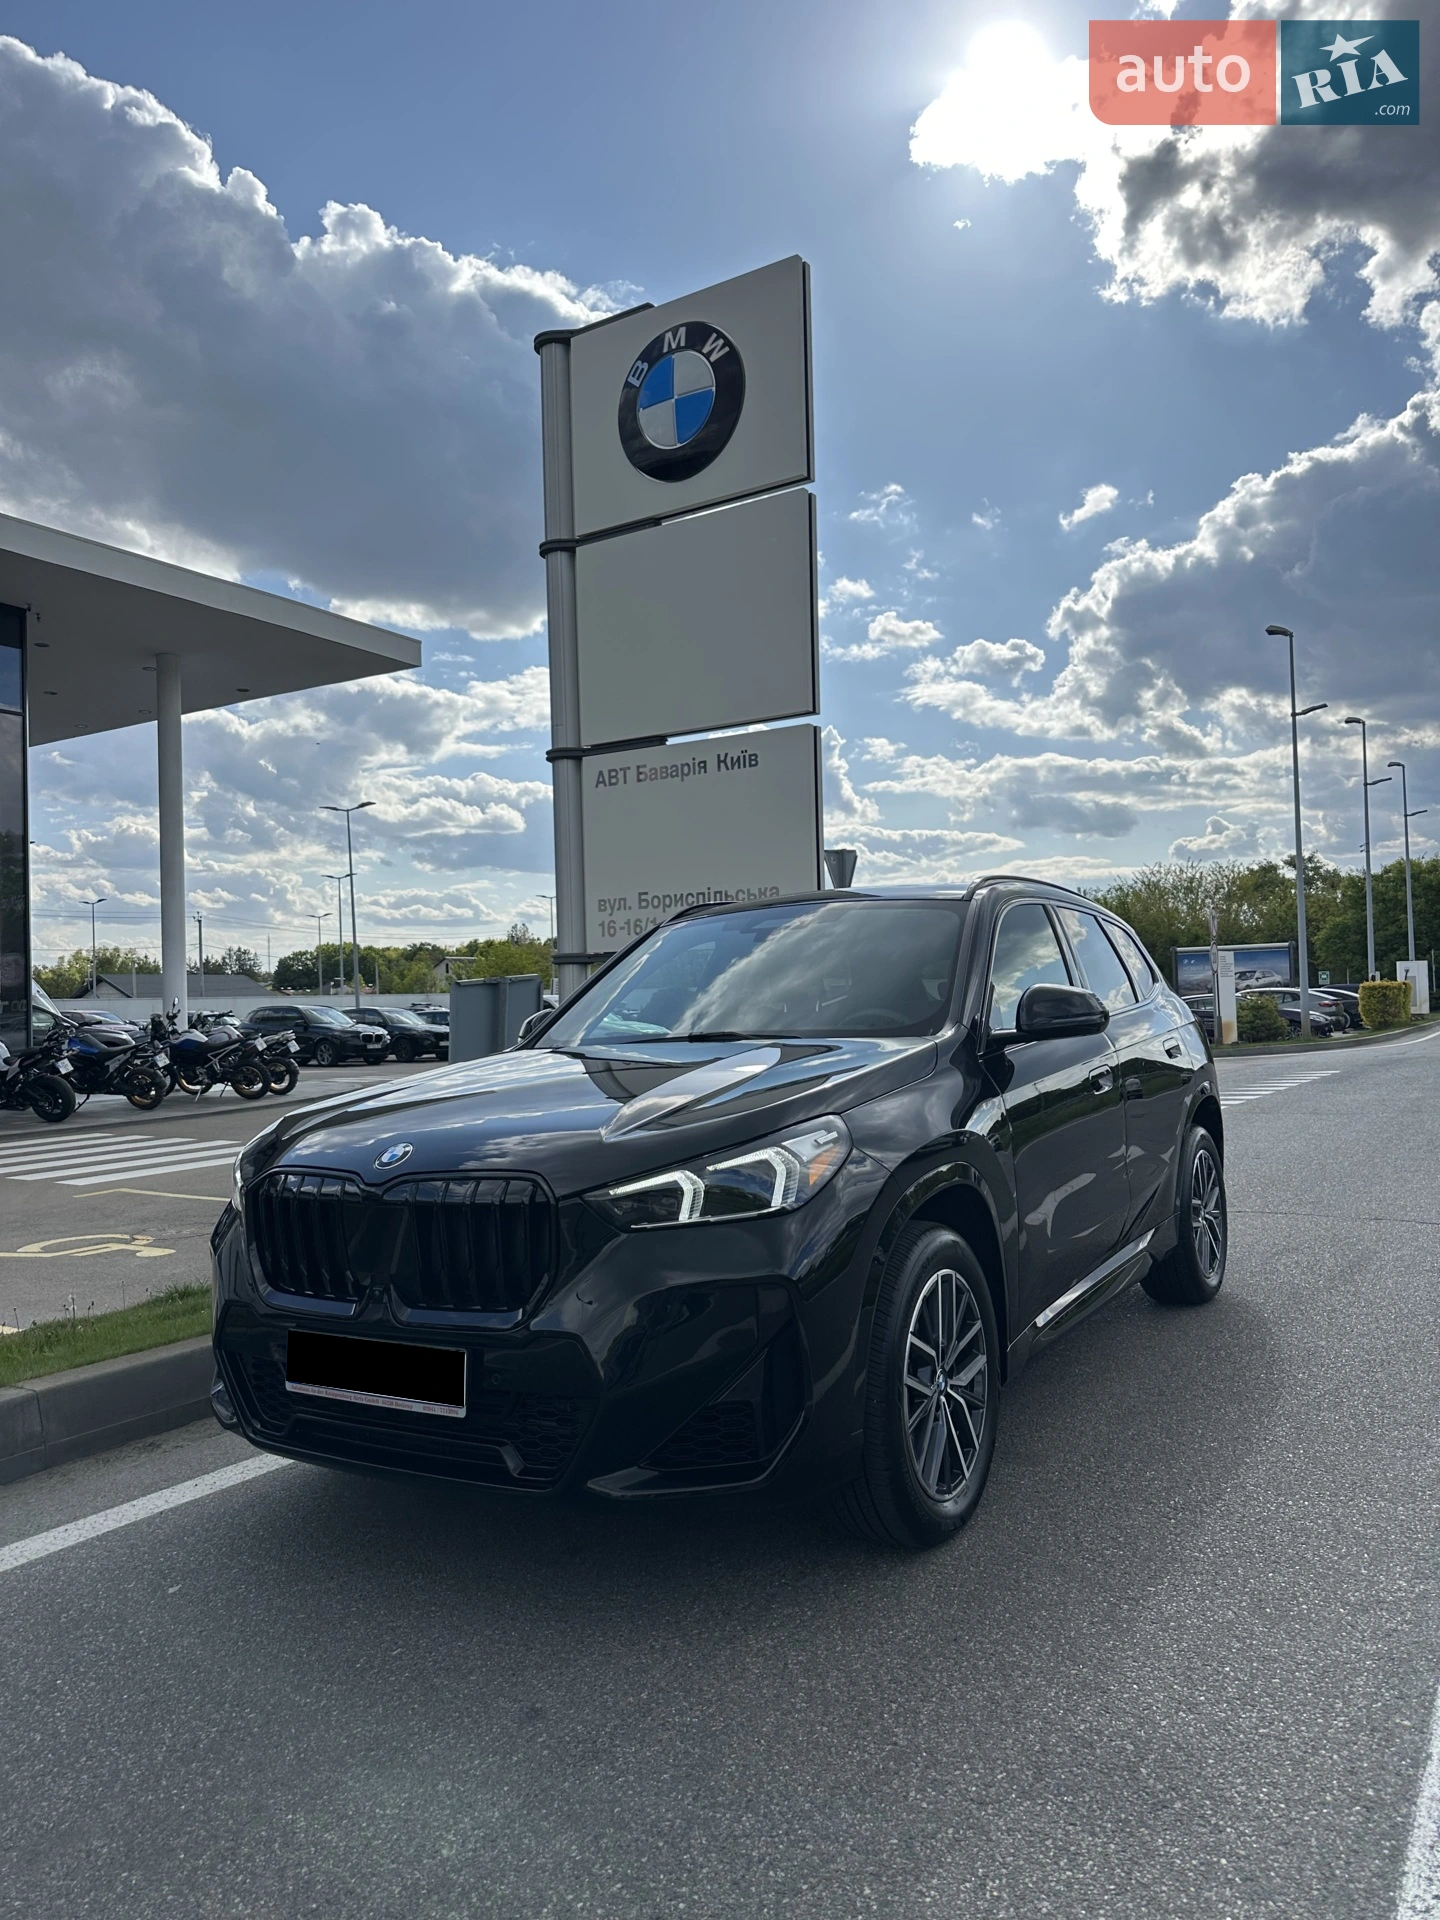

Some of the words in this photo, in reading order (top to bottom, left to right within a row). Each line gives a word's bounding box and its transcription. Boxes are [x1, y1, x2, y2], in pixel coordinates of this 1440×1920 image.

[627, 326, 730, 388] BMW
[595, 766, 631, 788] АВТ
[636, 757, 708, 782] Баварія
[717, 750, 759, 772] Київ
[598, 897, 632, 917] вул.
